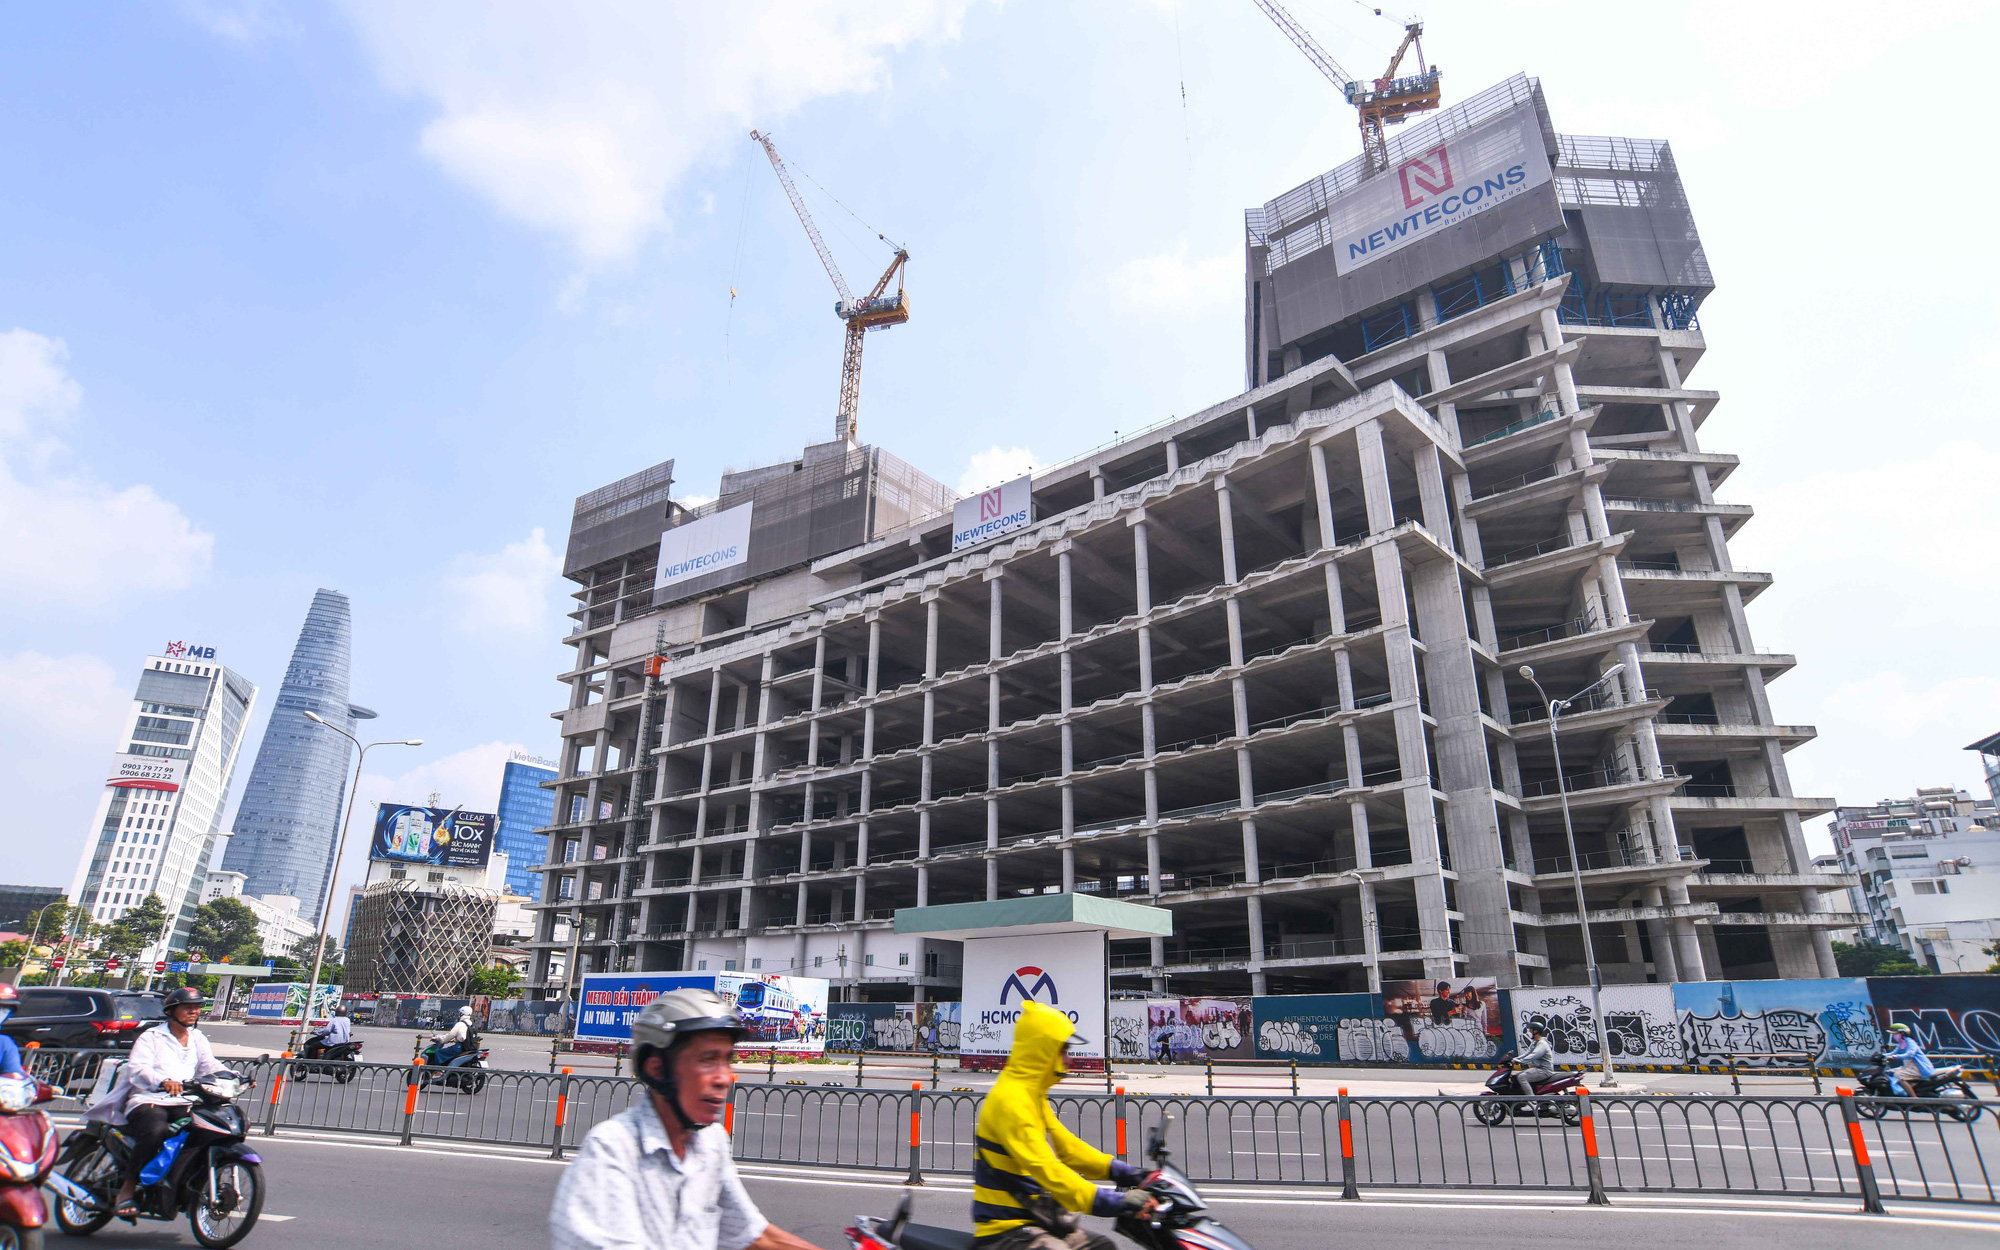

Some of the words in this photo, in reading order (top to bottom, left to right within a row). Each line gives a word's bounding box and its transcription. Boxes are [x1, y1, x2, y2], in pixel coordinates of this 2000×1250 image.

[1494, 183, 1527, 202] trust
[1349, 165, 1526, 260] NEWTECONS
[955, 510, 1027, 544] NEWTECONS
[664, 546, 737, 579] NEWTECONS
[188, 645, 216, 659] MB
[513, 750, 559, 769] VietinBank
[459, 812, 485, 821] CLEAR
[1887, 819, 1909, 827] HOTEL
[586, 990, 612, 1005] METRO
[613, 986, 629, 1006] BẾN
[583, 1010, 594, 1024] AN
[596, 1009, 615, 1025] TOÀN
[1283, 1015, 1339, 1023] AUTHENTICALLY
